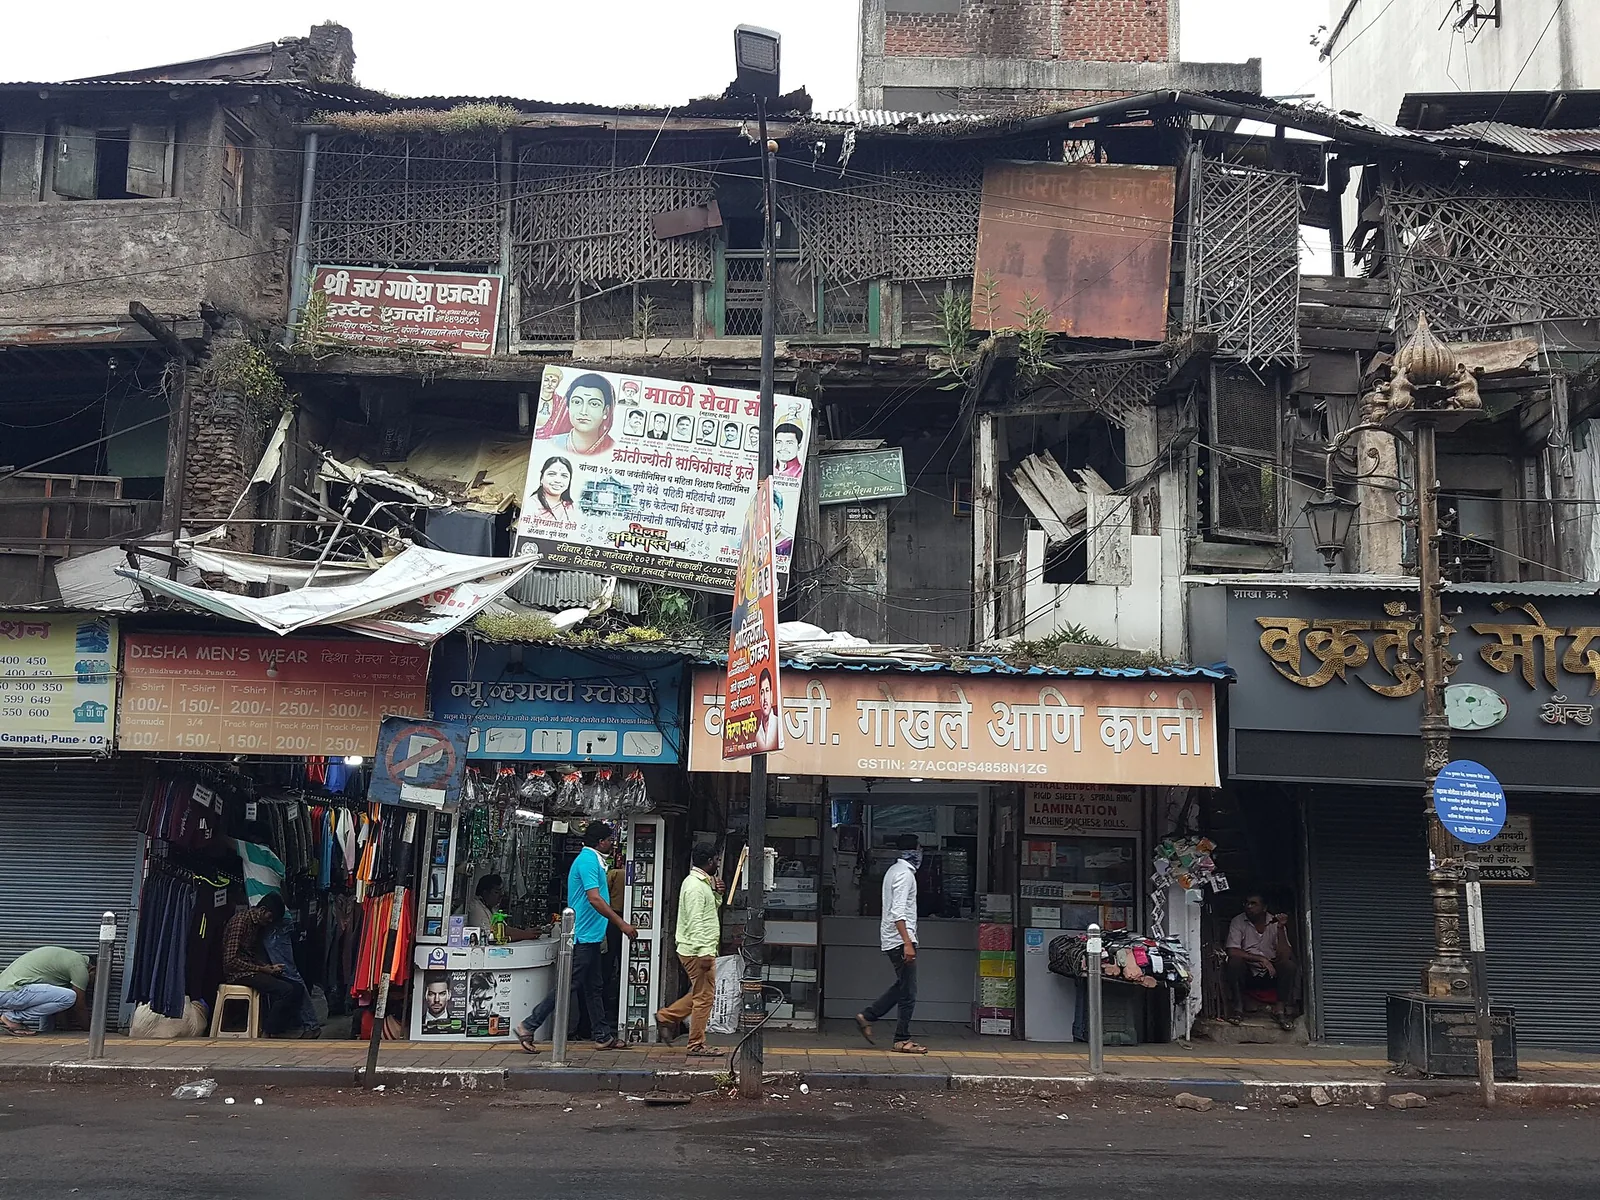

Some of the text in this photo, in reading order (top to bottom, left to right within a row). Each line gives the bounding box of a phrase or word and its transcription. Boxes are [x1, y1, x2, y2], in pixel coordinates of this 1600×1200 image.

[323, 270, 492, 306] श्री जय गणेश एजन्सी
[644, 384, 777, 417] माळी सेवा सं
[611, 446, 673, 469] क्रांतीज्योती
[675, 454, 732, 479] सावित्रीबाई
[735, 462, 755, 483] फुले
[632, 482, 736, 506] पुणे येथे पहिली महिलांची शाळा
[705, 521, 718, 536] फुले
[547, 552, 567, 564] स्थळ
[642, 564, 666, 579] हलवाई
[667, 567, 694, 582] गणपती
[602, 548, 634, 562] जानेवारी
[657, 554, 674, 568] रोजी
[676, 557, 702, 571] सकाळी
[1233, 590, 1262, 599] शाखा
[26, 656, 47, 665] 450
[130, 644, 308, 663] DISHA MEN'S WEAR
[320, 649, 420, 667] दिशा मेन्स वेअर
[15, 682, 63, 692] 300 350
[130, 682, 416, 699] T-Shirt T-Shirt T-Shirt T-Shirt T-Shirt T-Shirt
[450, 680, 488, 707] न्यू
[3, 694, 51, 704] 599 649
[1, 708, 50, 717] 550 600
[128, 698, 168, 712] 100/-
[179, 698, 220, 713] 150/-
[230, 700, 272, 715] 200/-
[279, 702, 320, 716] 250/-
[329, 702, 368, 718] 300/-
[783, 678, 840, 746] जी.
[856, 680, 973, 750] गोखले
[987, 684, 1086, 753] आणि
[224, 719, 247, 728] Track
[250, 720, 268, 728] Pant
[276, 722, 299, 730] Track
[302, 722, 320, 730] Pant
[325, 722, 348, 731] Track
[351, 723, 369, 732] Pant
[0, 733, 48, 745] Ganpati,
[51, 734, 79, 744] Pune
[89, 736, 104, 744] 02
[176, 733, 216, 747] 150/-
[228, 734, 268, 748] 150/-
[276, 736, 316, 750] 200/-
[326, 737, 365, 751] 250/-
[857, 758, 906, 770] GSTIN:
[1033, 792, 1052, 800] RIGID
[1055, 792, 1077, 801] SHEET
[1090, 794, 1115, 802] SPIRAL
[1116, 794, 1132, 803] RING
[1034, 803, 1118, 816] LAMINATION
[1029, 816, 1128, 828] MACHINE ROLLS.
